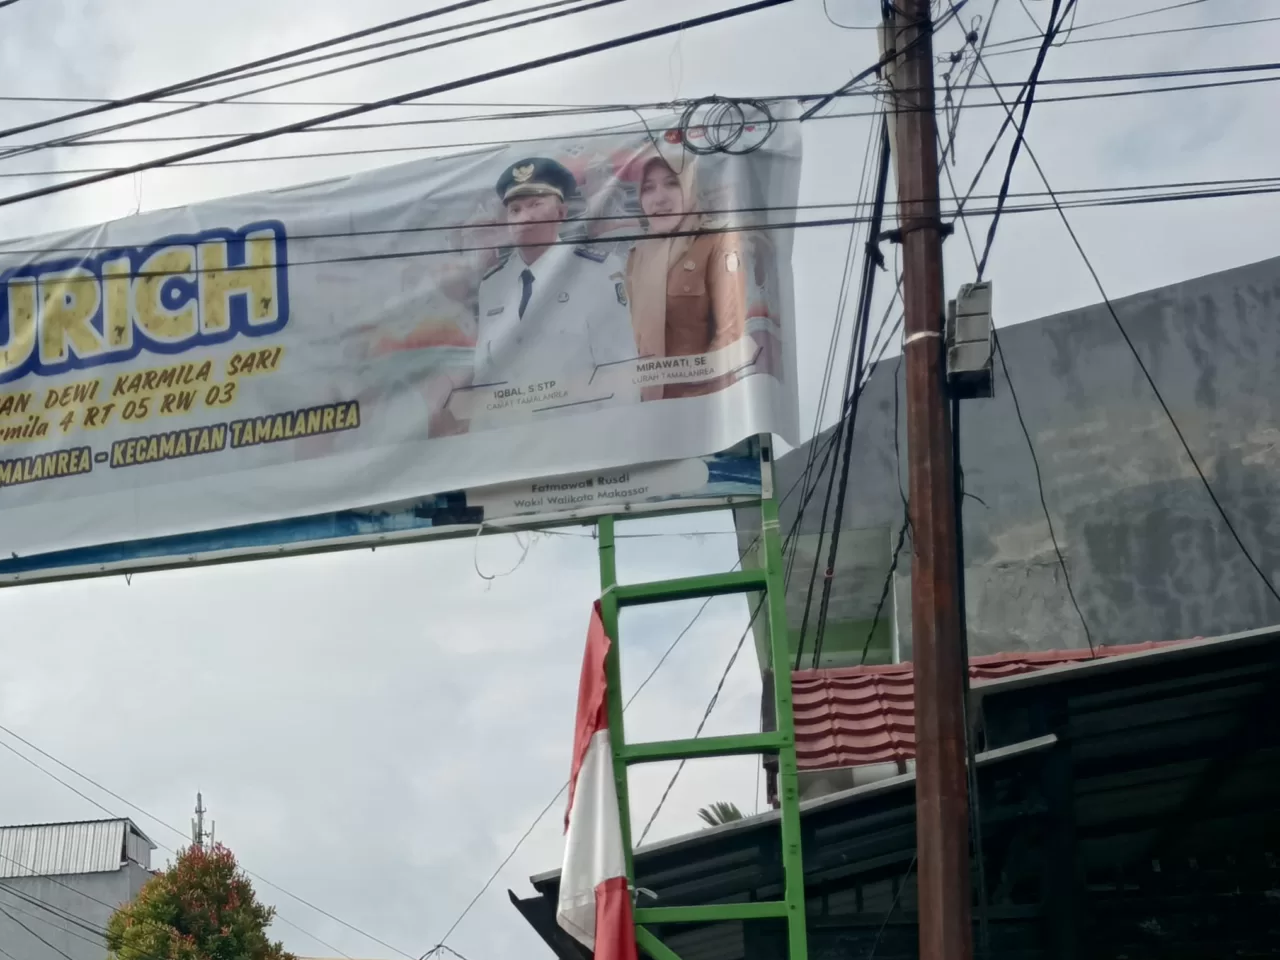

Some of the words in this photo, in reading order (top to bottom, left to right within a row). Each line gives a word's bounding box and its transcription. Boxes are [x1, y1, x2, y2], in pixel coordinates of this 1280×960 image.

[694, 356, 707, 366] SE
[44, 380, 100, 409] DEWI
[112, 361, 213, 397] KARMILA
[227, 347, 282, 377] SARI
[632, 374, 659, 385] LURAH
[661, 368, 715, 379] TAMALANREA
[60, 411, 75, 433] 4
[83, 403, 116, 428] RT
[122, 398, 152, 421] 05
[160, 390, 197, 414] RW
[204, 382, 236, 406] 03
[517, 390, 569, 405] TAMALANREA
[111, 424, 227, 468] KECAMATAN
[230, 402, 360, 448] TAMALANREA
[597, 473, 630, 486] Rusdi
[513, 499, 544, 509] Wakil
[548, 493, 594, 505] Walikota
[597, 485, 650, 499] Makassar
